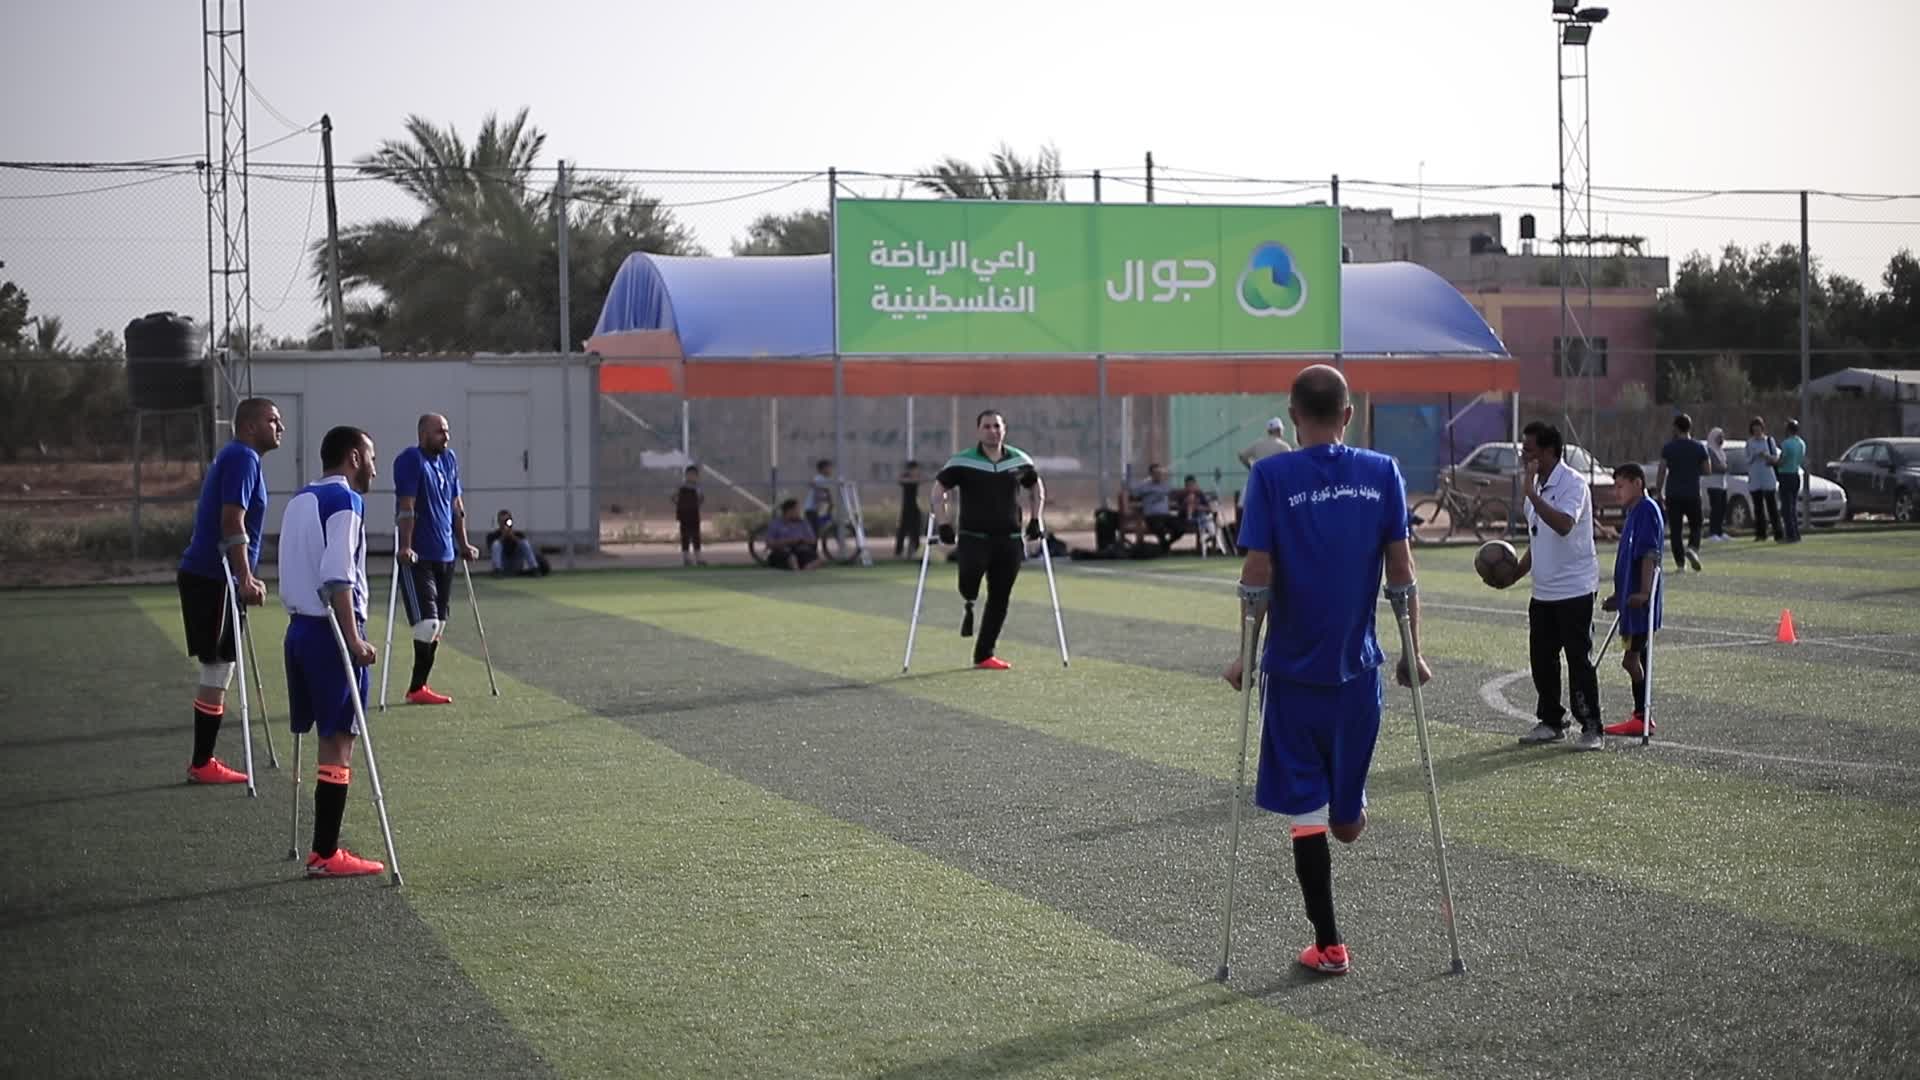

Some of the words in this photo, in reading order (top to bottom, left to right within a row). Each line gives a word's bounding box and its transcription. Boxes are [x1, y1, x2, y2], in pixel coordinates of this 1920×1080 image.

[870, 239, 967, 275] الرياضة
[971, 240, 1035, 282] راعي
[1106, 259, 1217, 302] جوال
[871, 284, 1035, 320] الفلسطينية
[1288, 491, 1307, 507] 2017
[1310, 486, 1330, 504] كوري
[1359, 484, 1381, 502] بطولة
